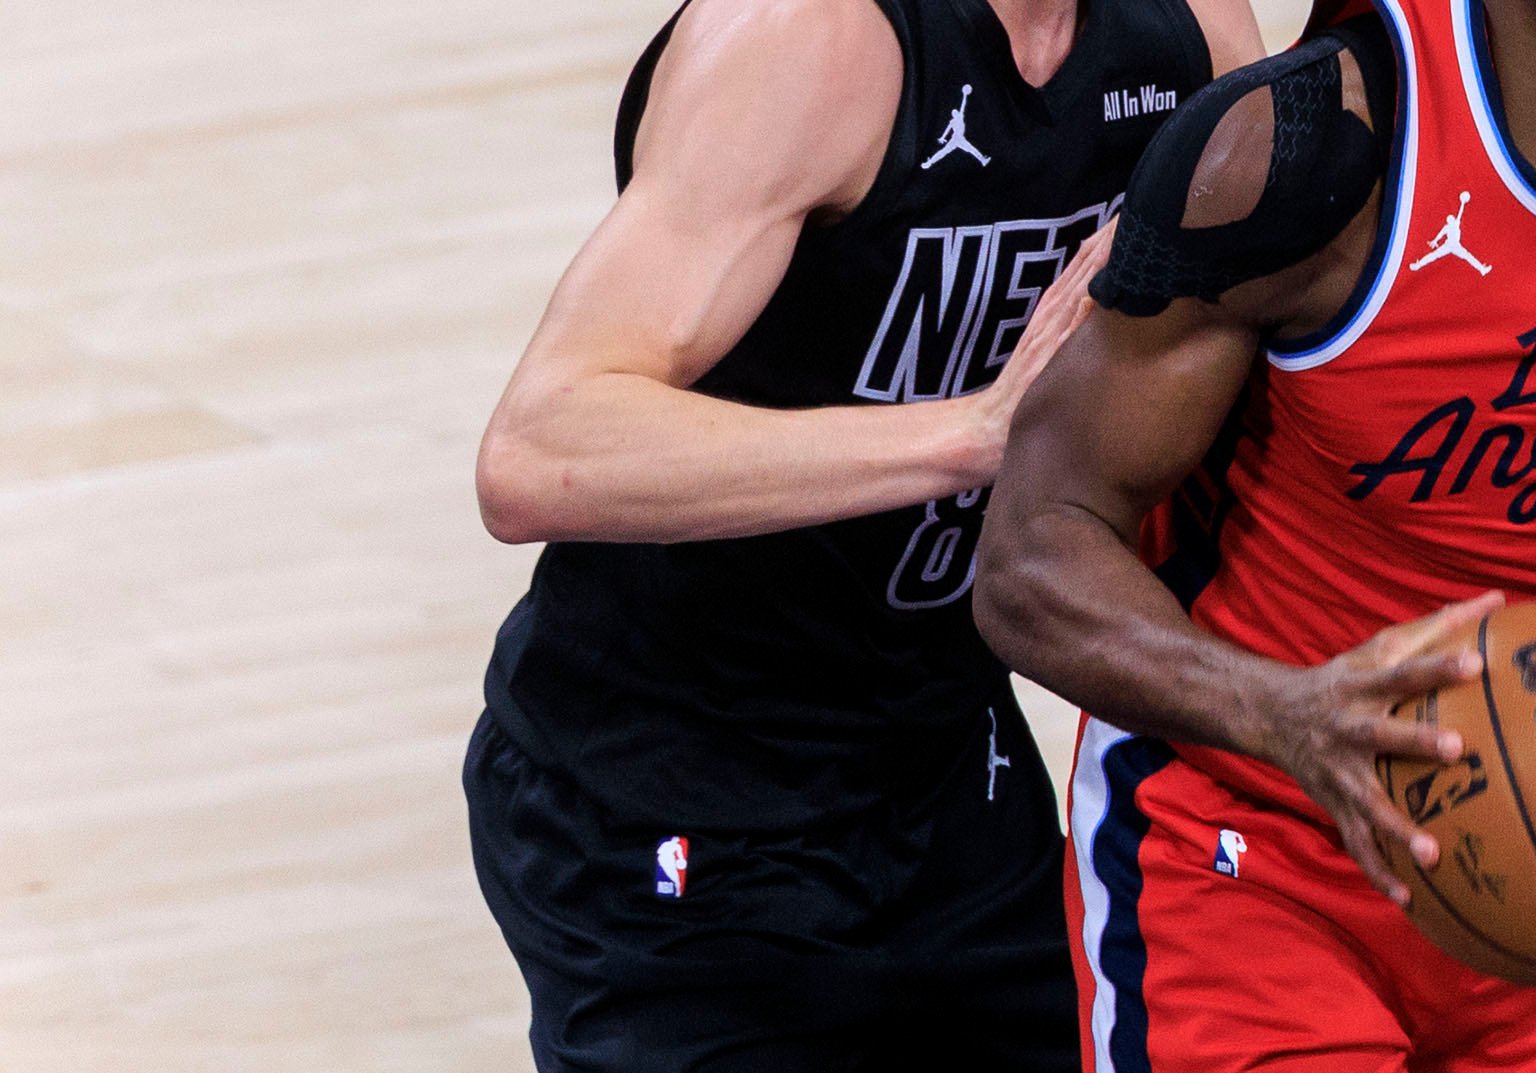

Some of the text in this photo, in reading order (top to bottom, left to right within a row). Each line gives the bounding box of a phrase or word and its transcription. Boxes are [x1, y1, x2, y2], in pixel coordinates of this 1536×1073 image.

[1104, 84, 1176, 122] All In Won
